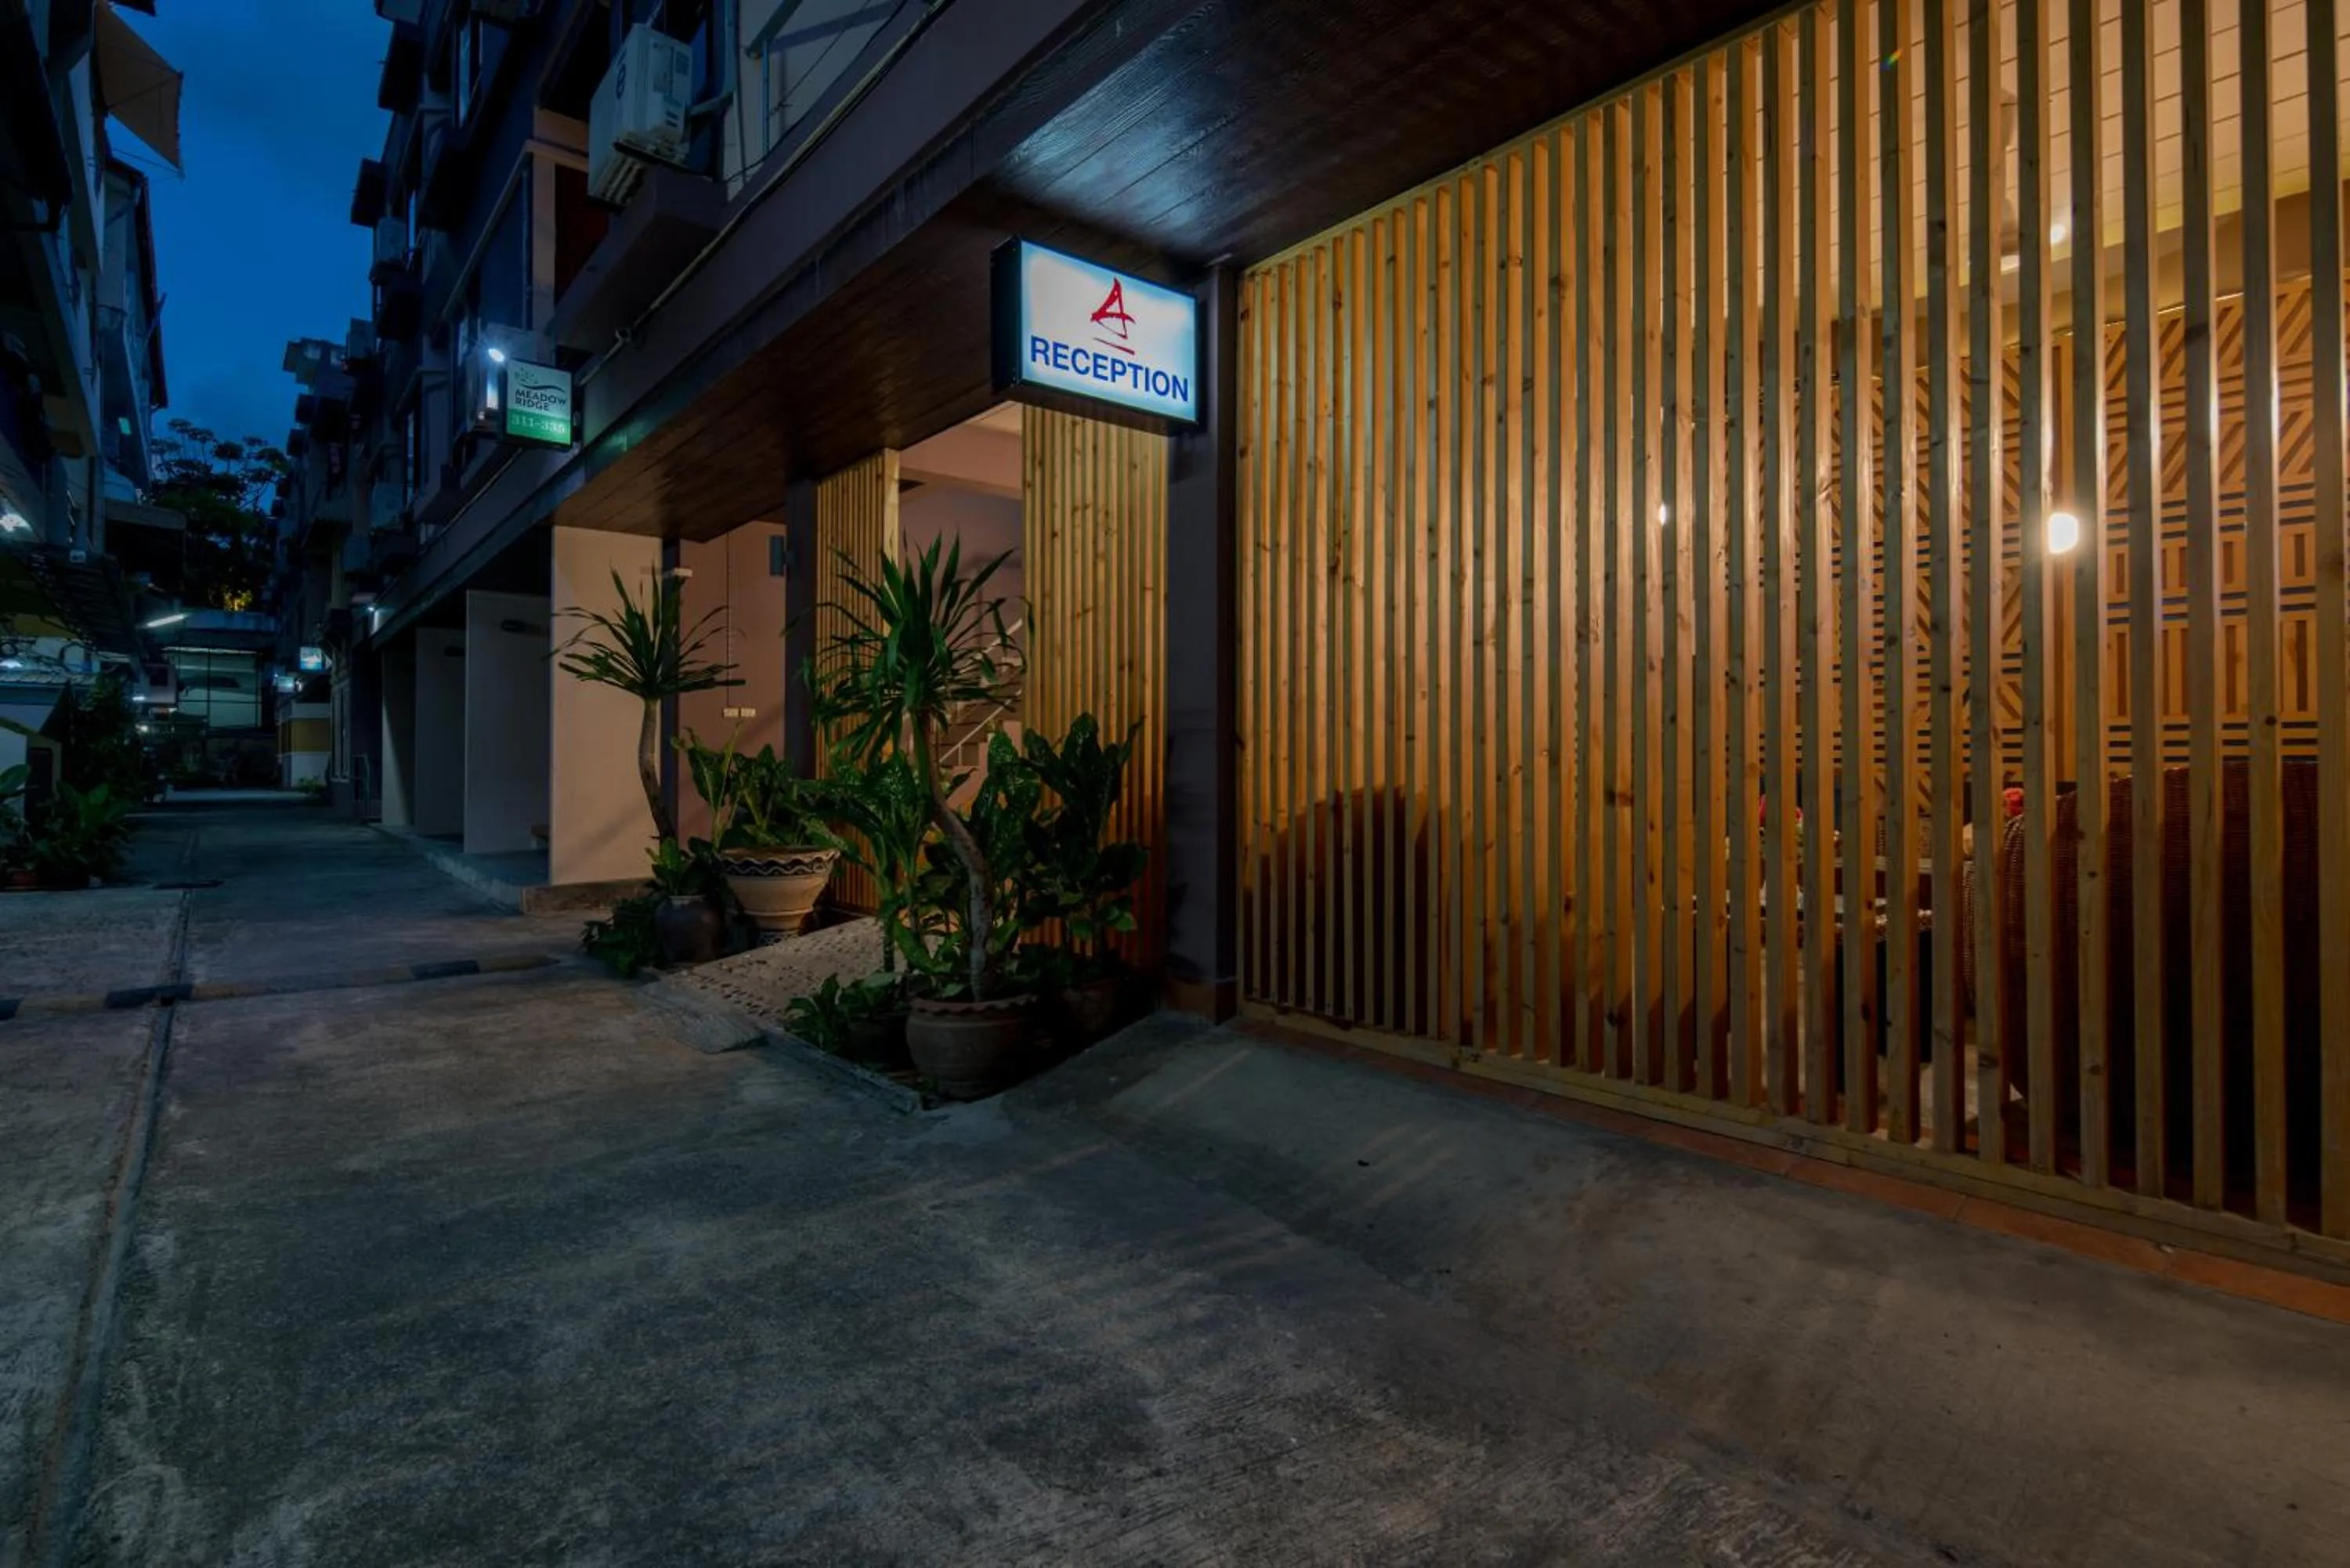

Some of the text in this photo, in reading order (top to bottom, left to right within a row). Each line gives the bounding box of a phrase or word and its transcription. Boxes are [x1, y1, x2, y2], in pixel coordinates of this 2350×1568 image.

[1030, 335, 1188, 401] RECEPTION
[515, 388, 566, 407] MEADOW
[515, 397, 550, 411] RIDGE
